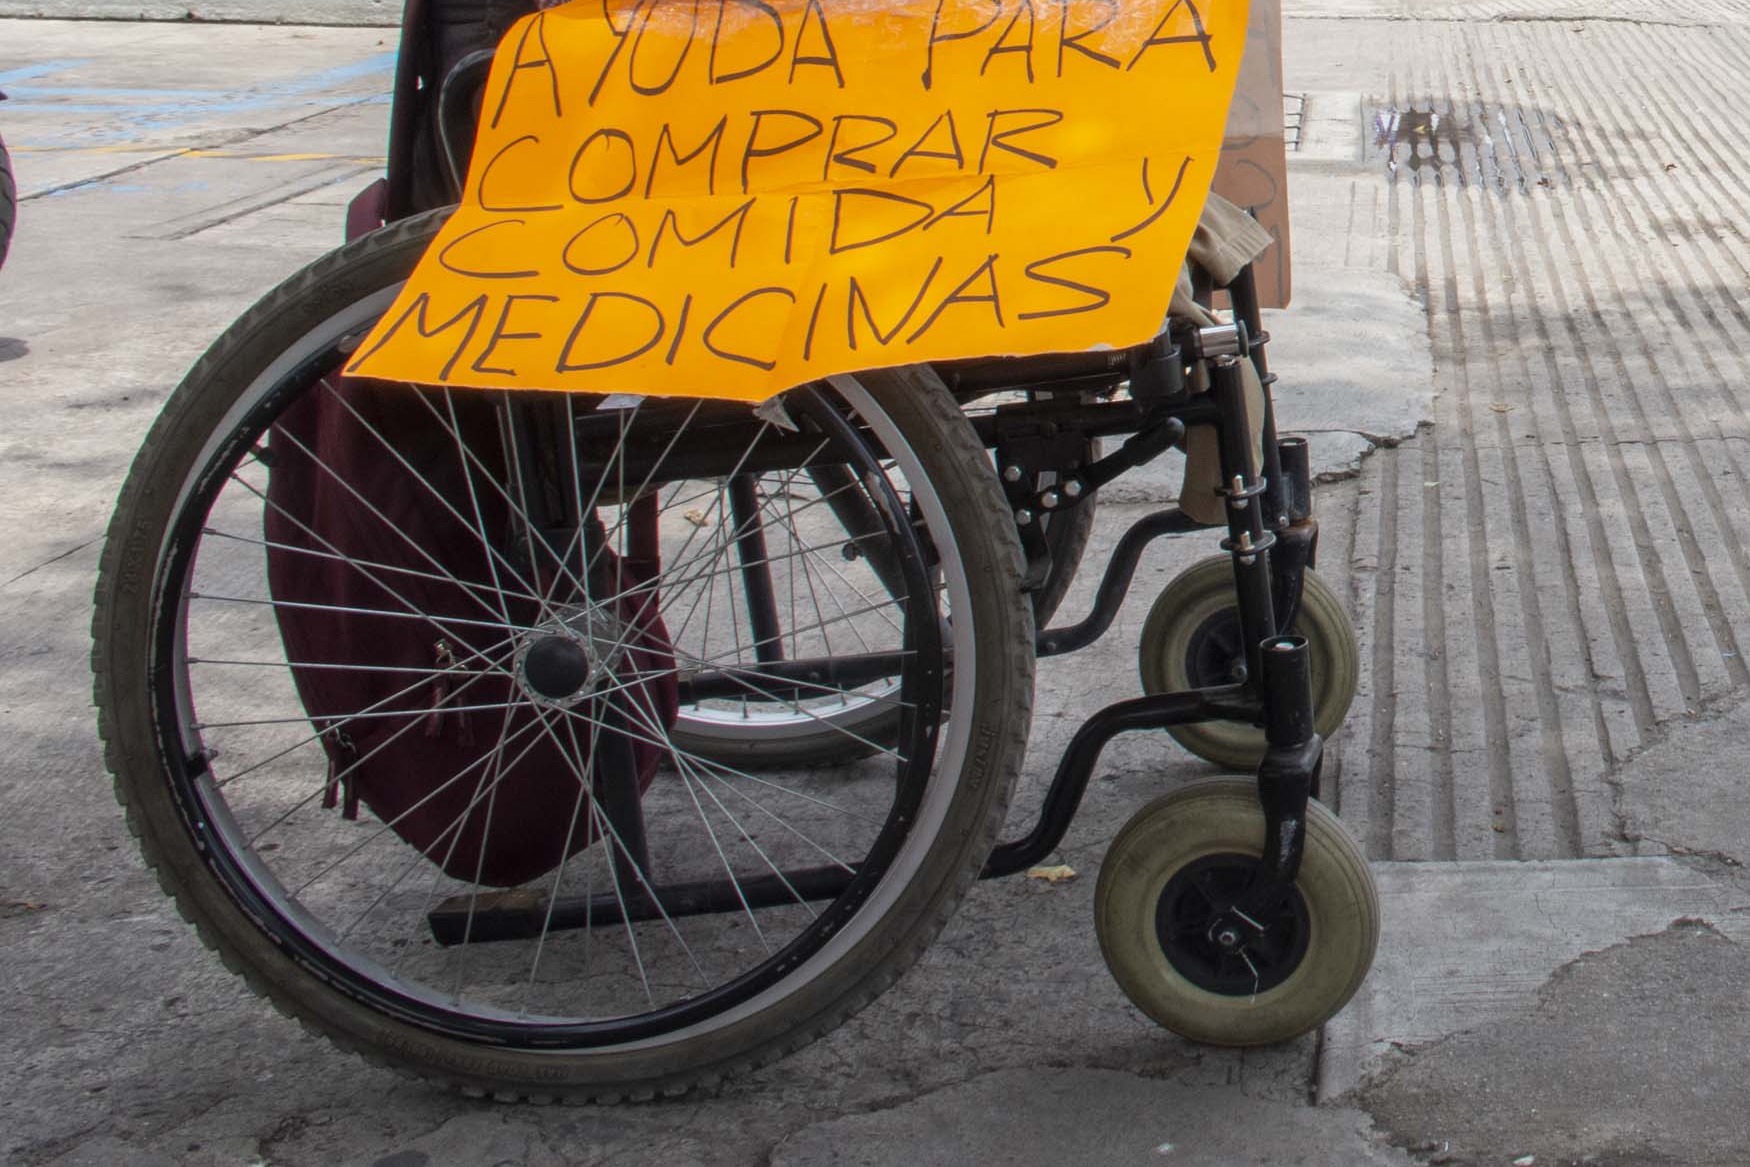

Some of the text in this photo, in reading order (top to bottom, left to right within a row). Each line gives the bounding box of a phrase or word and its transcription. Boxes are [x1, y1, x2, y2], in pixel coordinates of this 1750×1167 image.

[478, 107, 1064, 212] COMPRAR
[437, 173, 995, 278] COMIDA
[347, 246, 1132, 380] MEDICINAS
